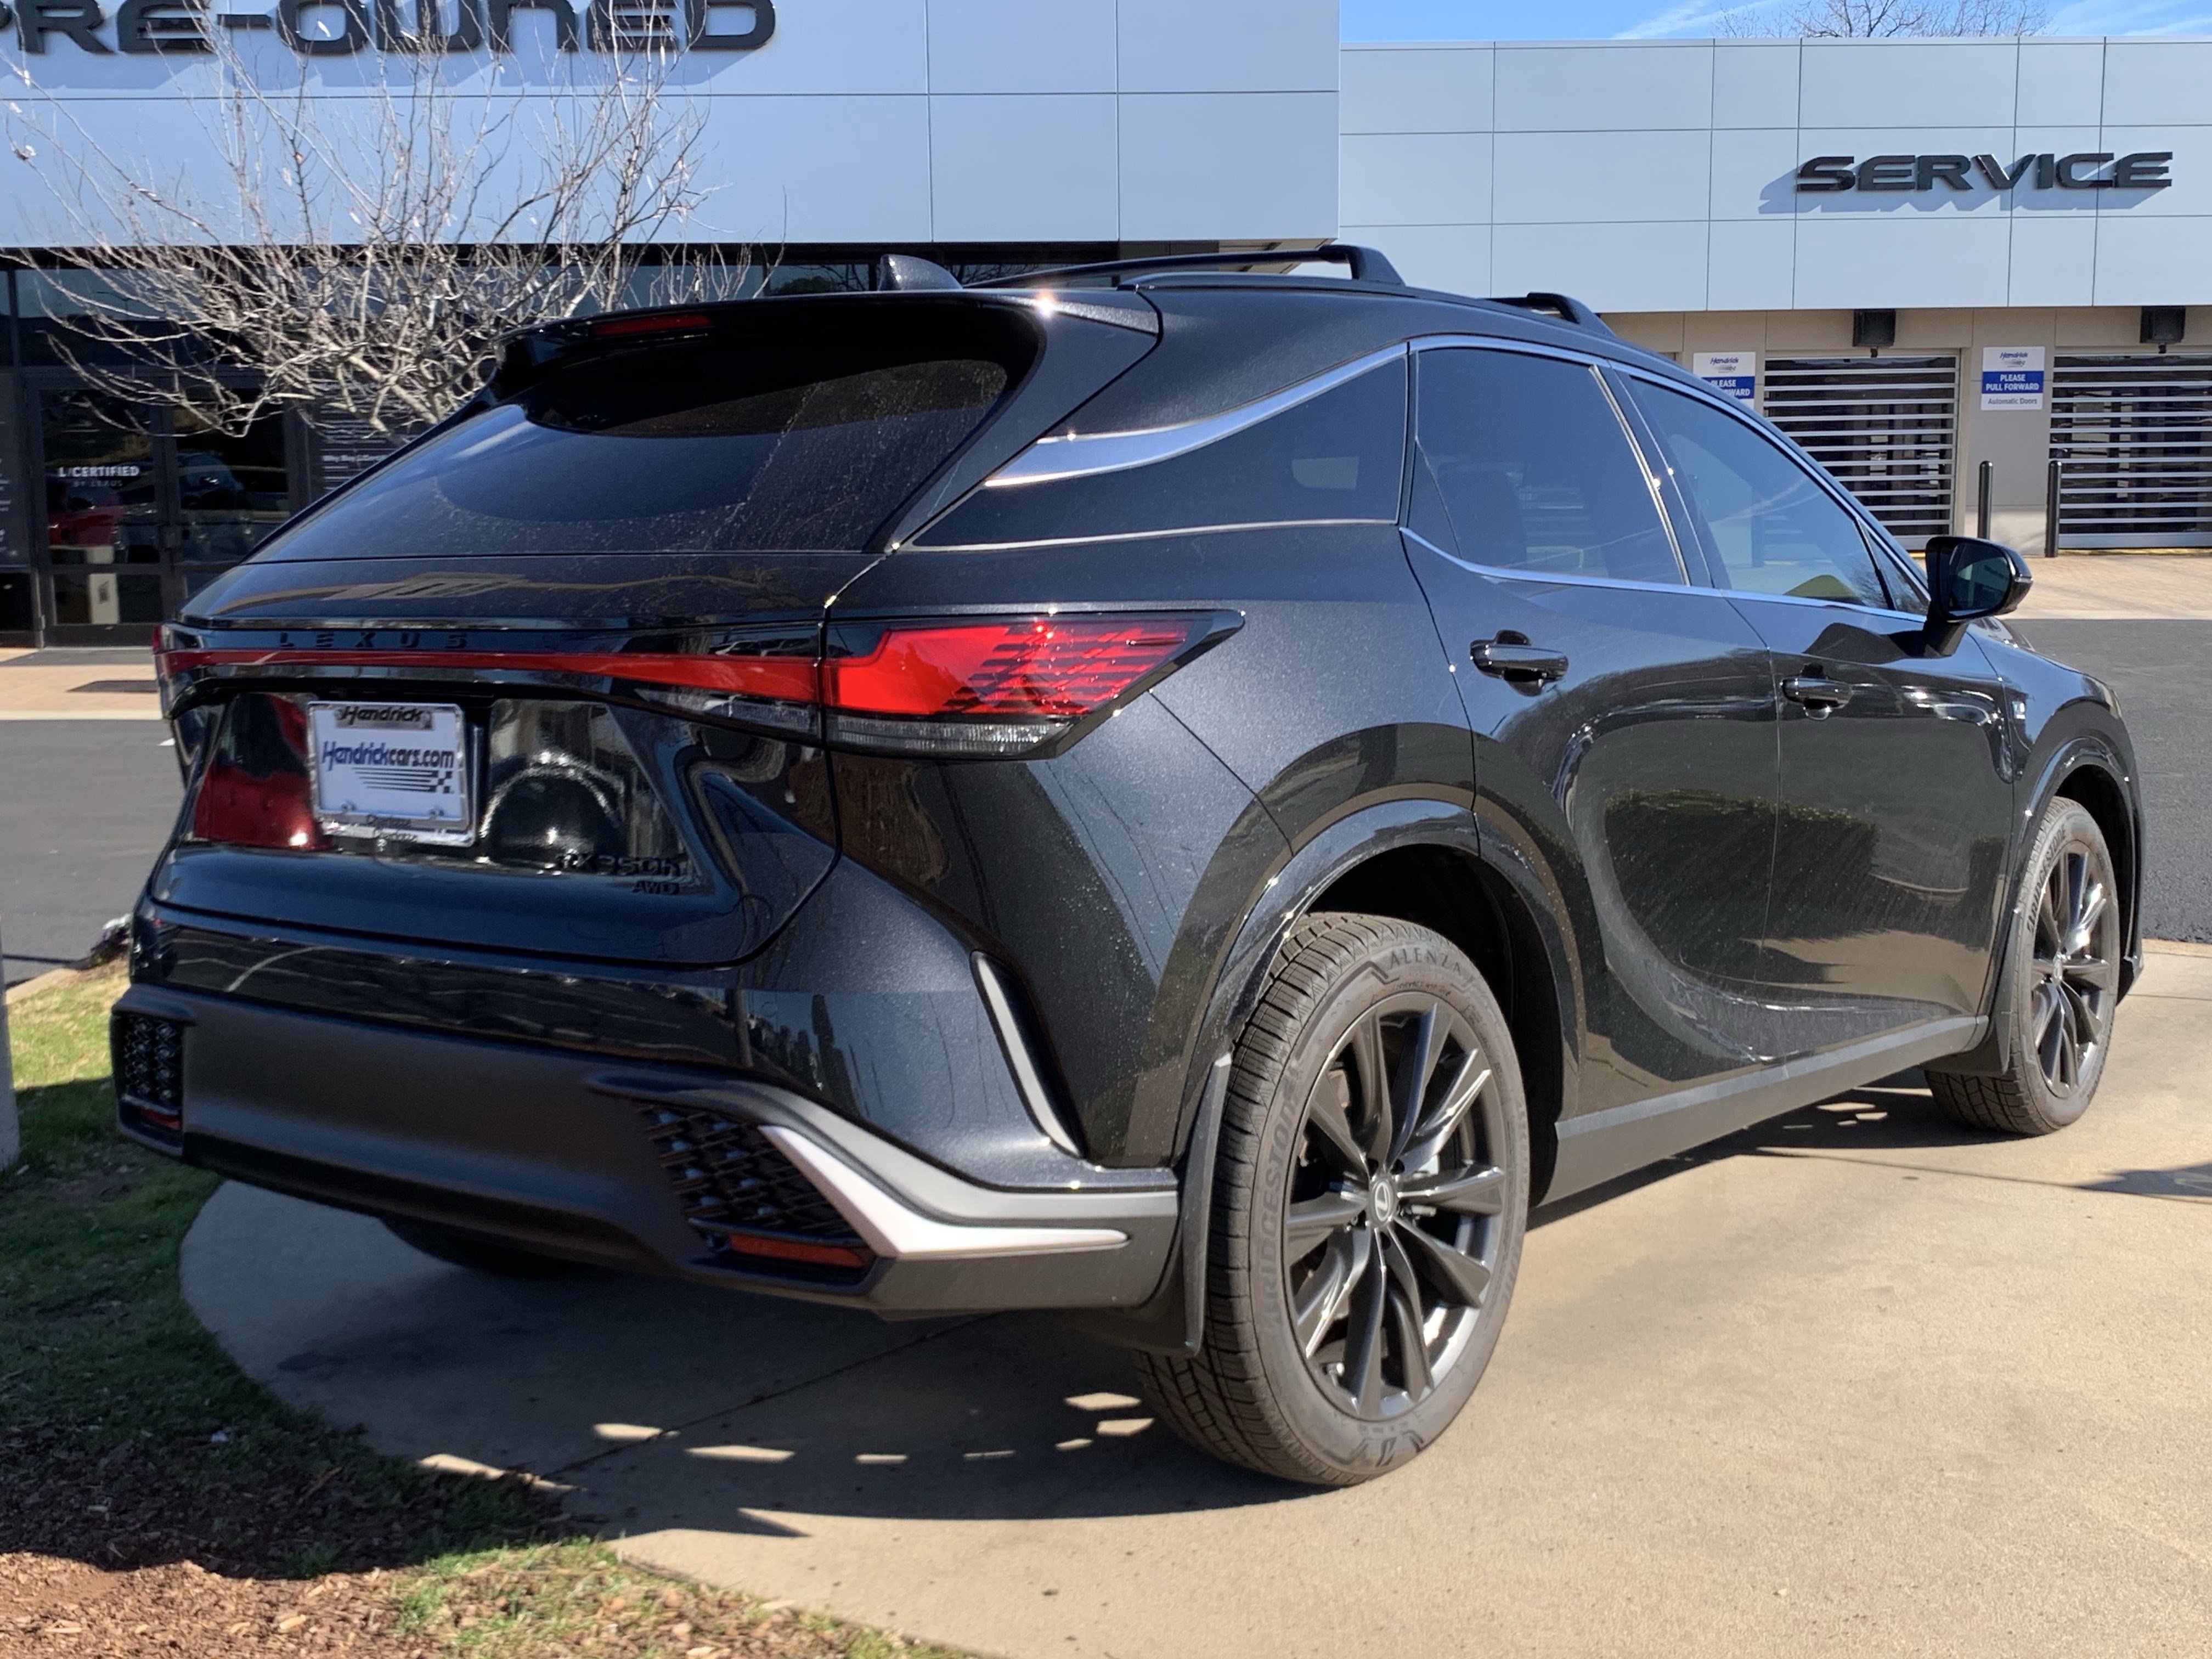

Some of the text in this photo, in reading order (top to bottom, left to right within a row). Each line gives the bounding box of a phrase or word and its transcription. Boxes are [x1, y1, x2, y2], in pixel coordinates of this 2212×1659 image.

[1797, 152, 2172, 191] SERVICE
[1710, 357, 1739, 365] Hendrick
[2000, 352, 2028, 360] Hendrick
[279, 631, 466, 650] LEXUS
[340, 706, 425, 725] Hendrick
[321, 741, 454, 771] Hendrickcars.com
[632, 881, 680, 895] AWD
[1390, 947, 1462, 975] ALENZA
